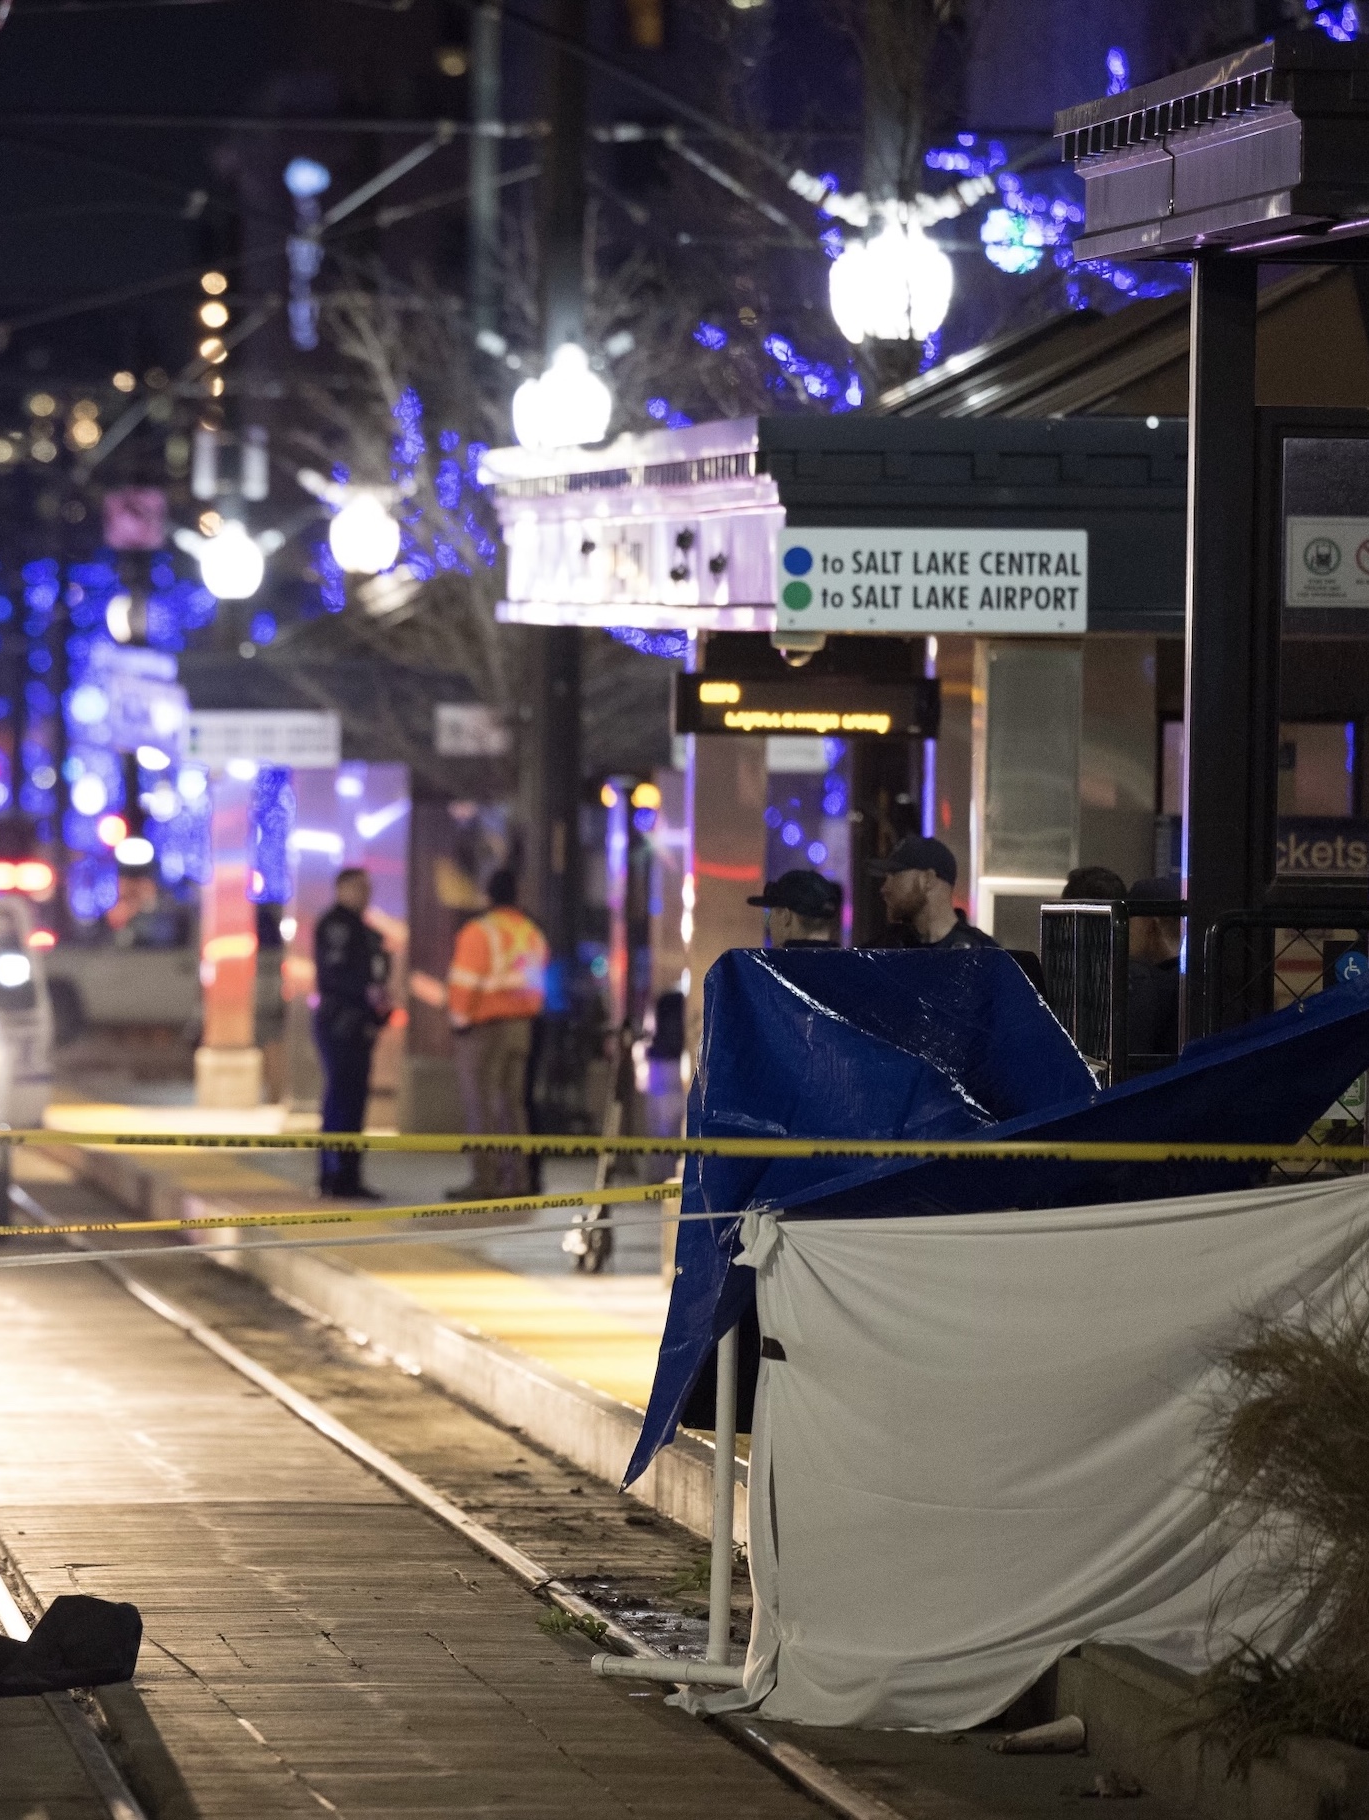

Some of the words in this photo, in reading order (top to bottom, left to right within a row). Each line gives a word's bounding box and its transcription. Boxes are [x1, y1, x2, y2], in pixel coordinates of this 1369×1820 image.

[822, 554, 843, 575] to
[852, 550, 902, 575] SALT
[913, 551, 970, 575] LAKE
[980, 551, 1081, 577] CENTRAL
[822, 588, 843, 608] to
[852, 585, 902, 609] SALT
[913, 585, 970, 610] LAKE
[979, 585, 1079, 611] AIRPORT
